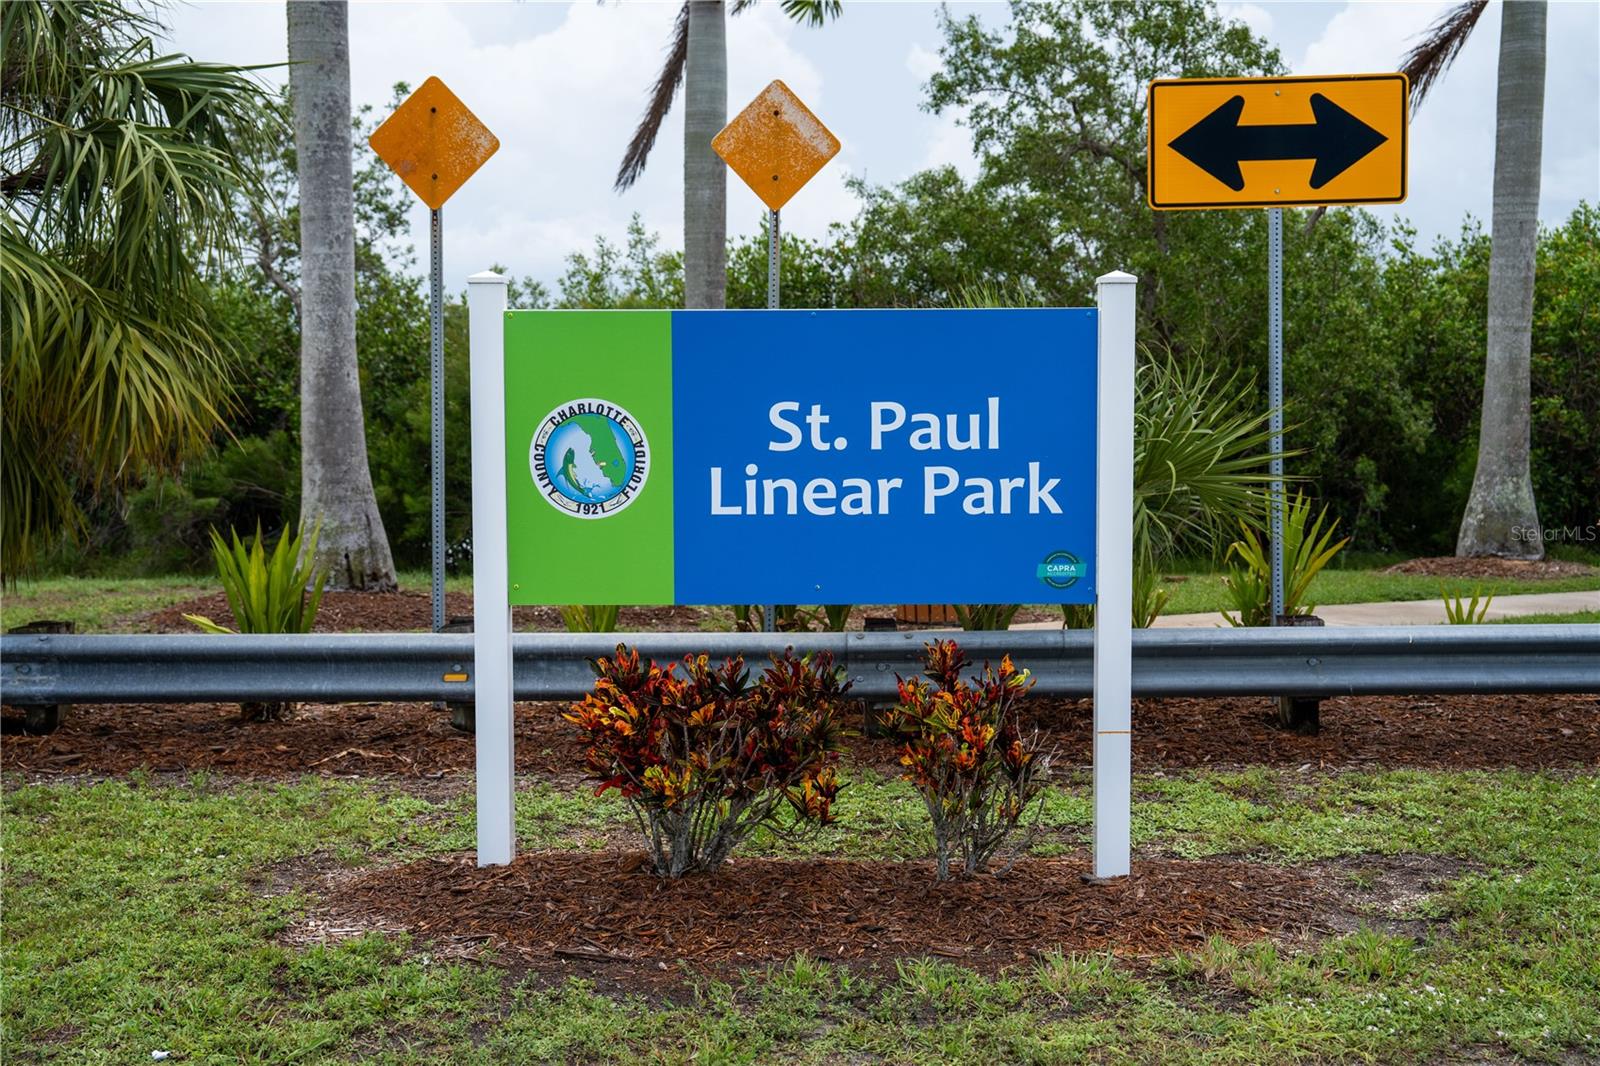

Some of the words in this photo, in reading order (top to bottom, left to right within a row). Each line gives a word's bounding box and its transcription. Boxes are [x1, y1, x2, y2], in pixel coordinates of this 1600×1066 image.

[549, 402, 630, 427] CHARLOTTE
[768, 401, 848, 451] St.
[870, 397, 1000, 450] Paul
[533, 443, 558, 497] COUNTY
[622, 439, 646, 499] FLORIDA
[710, 463, 903, 516] Linear
[924, 461, 1063, 515] Park
[576, 503, 606, 515] 1921
[1047, 564, 1076, 572] CAPRA
